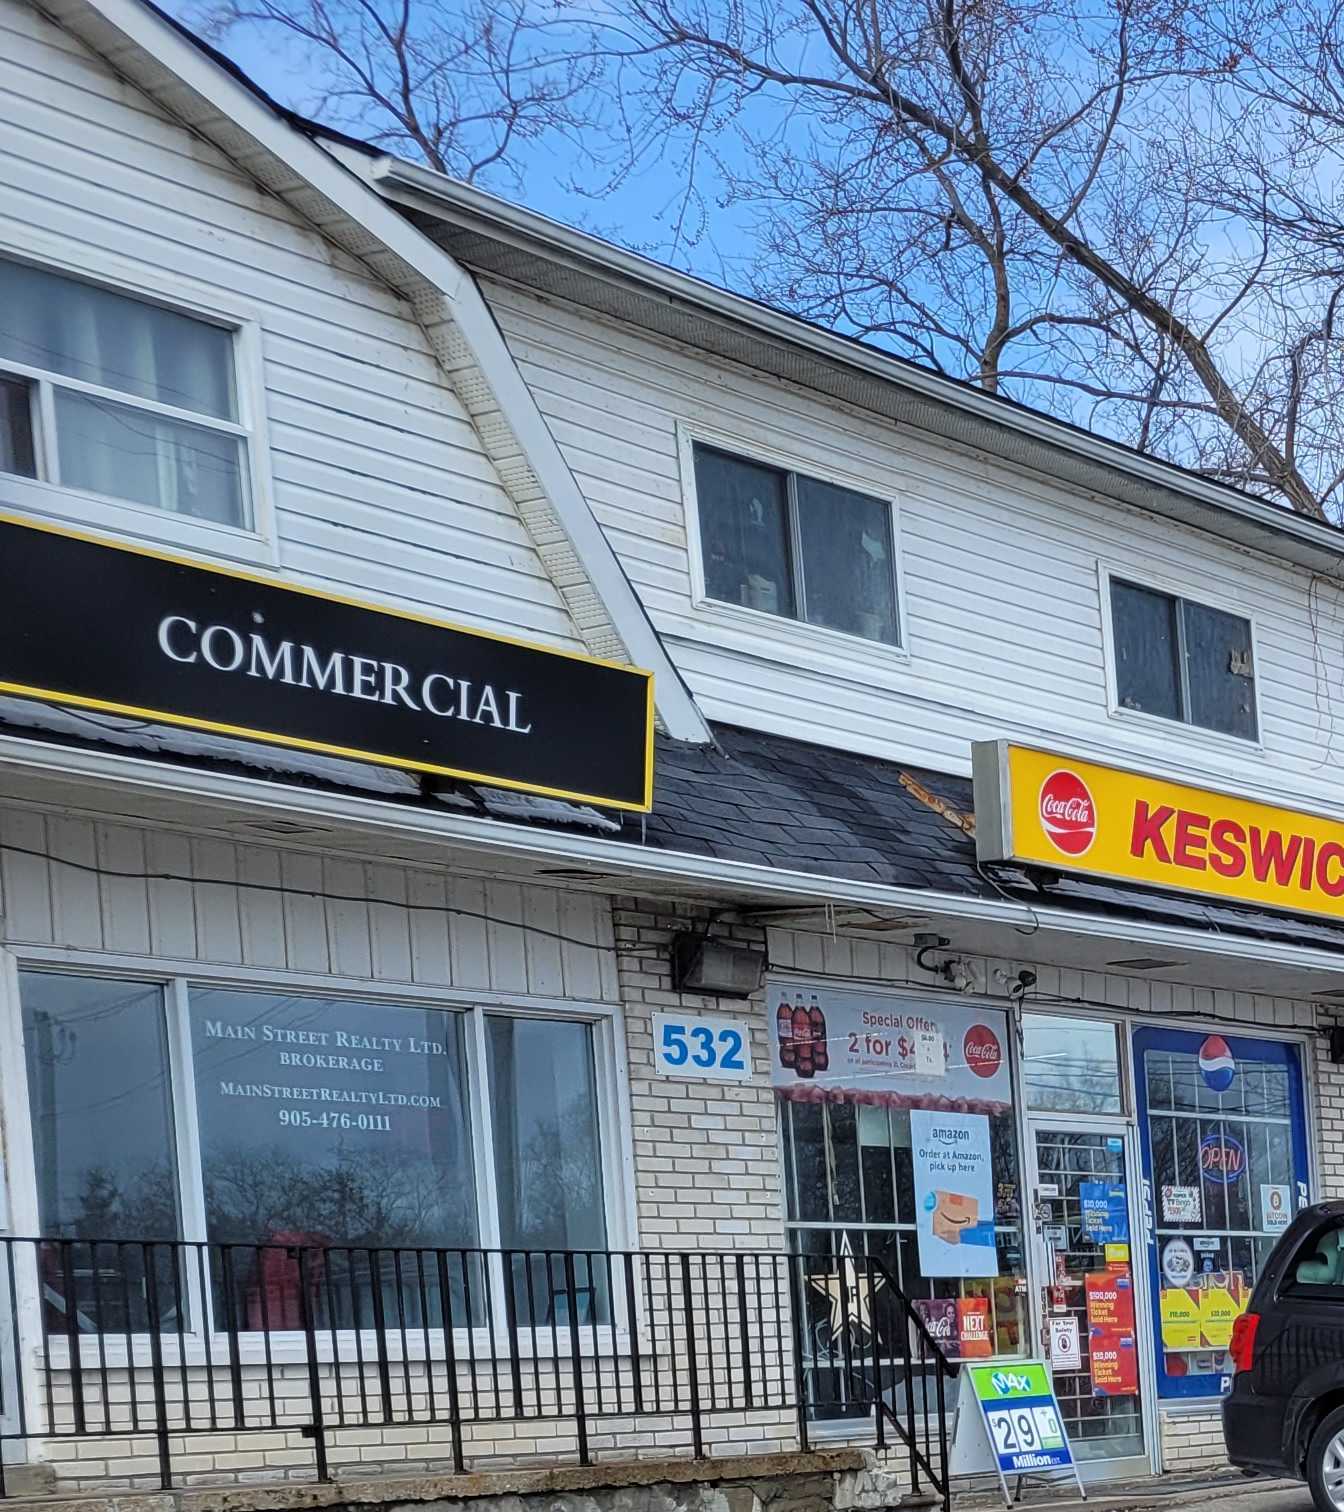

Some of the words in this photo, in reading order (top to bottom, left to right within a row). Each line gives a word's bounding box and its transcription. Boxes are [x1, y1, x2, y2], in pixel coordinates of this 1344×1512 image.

[157, 616, 532, 735] COMMERCIAL
[1042, 794, 1090, 822] Coca-Cola
[862, 1011, 902, 1029] Special
[906, 1015, 935, 1031] Offer
[662, 1024, 745, 1071] 532
[848, 1032, 860, 1053] 2
[864, 1033, 891, 1056] for
[280, 1052, 384, 1072] BROKERAGE
[279, 1109, 392, 1132] 905-476-0111
[932, 1128, 969, 1141] amazon
[919, 1149, 941, 1158] Order
[943, 1151, 950, 1160] at
[952, 1151, 984, 1161] Amazon,
[1201, 1144, 1241, 1171] OPEN
[930, 1162, 945, 1172] pick
[947, 1164, 957, 1173] up
[959, 1163, 975, 1172] here
[963, 1315, 984, 1331] NEXT
[961, 1331, 989, 1340] CHALLENGE
[992, 1372, 1030, 1394] MAX
[1012, 1454, 1051, 1468] Million
